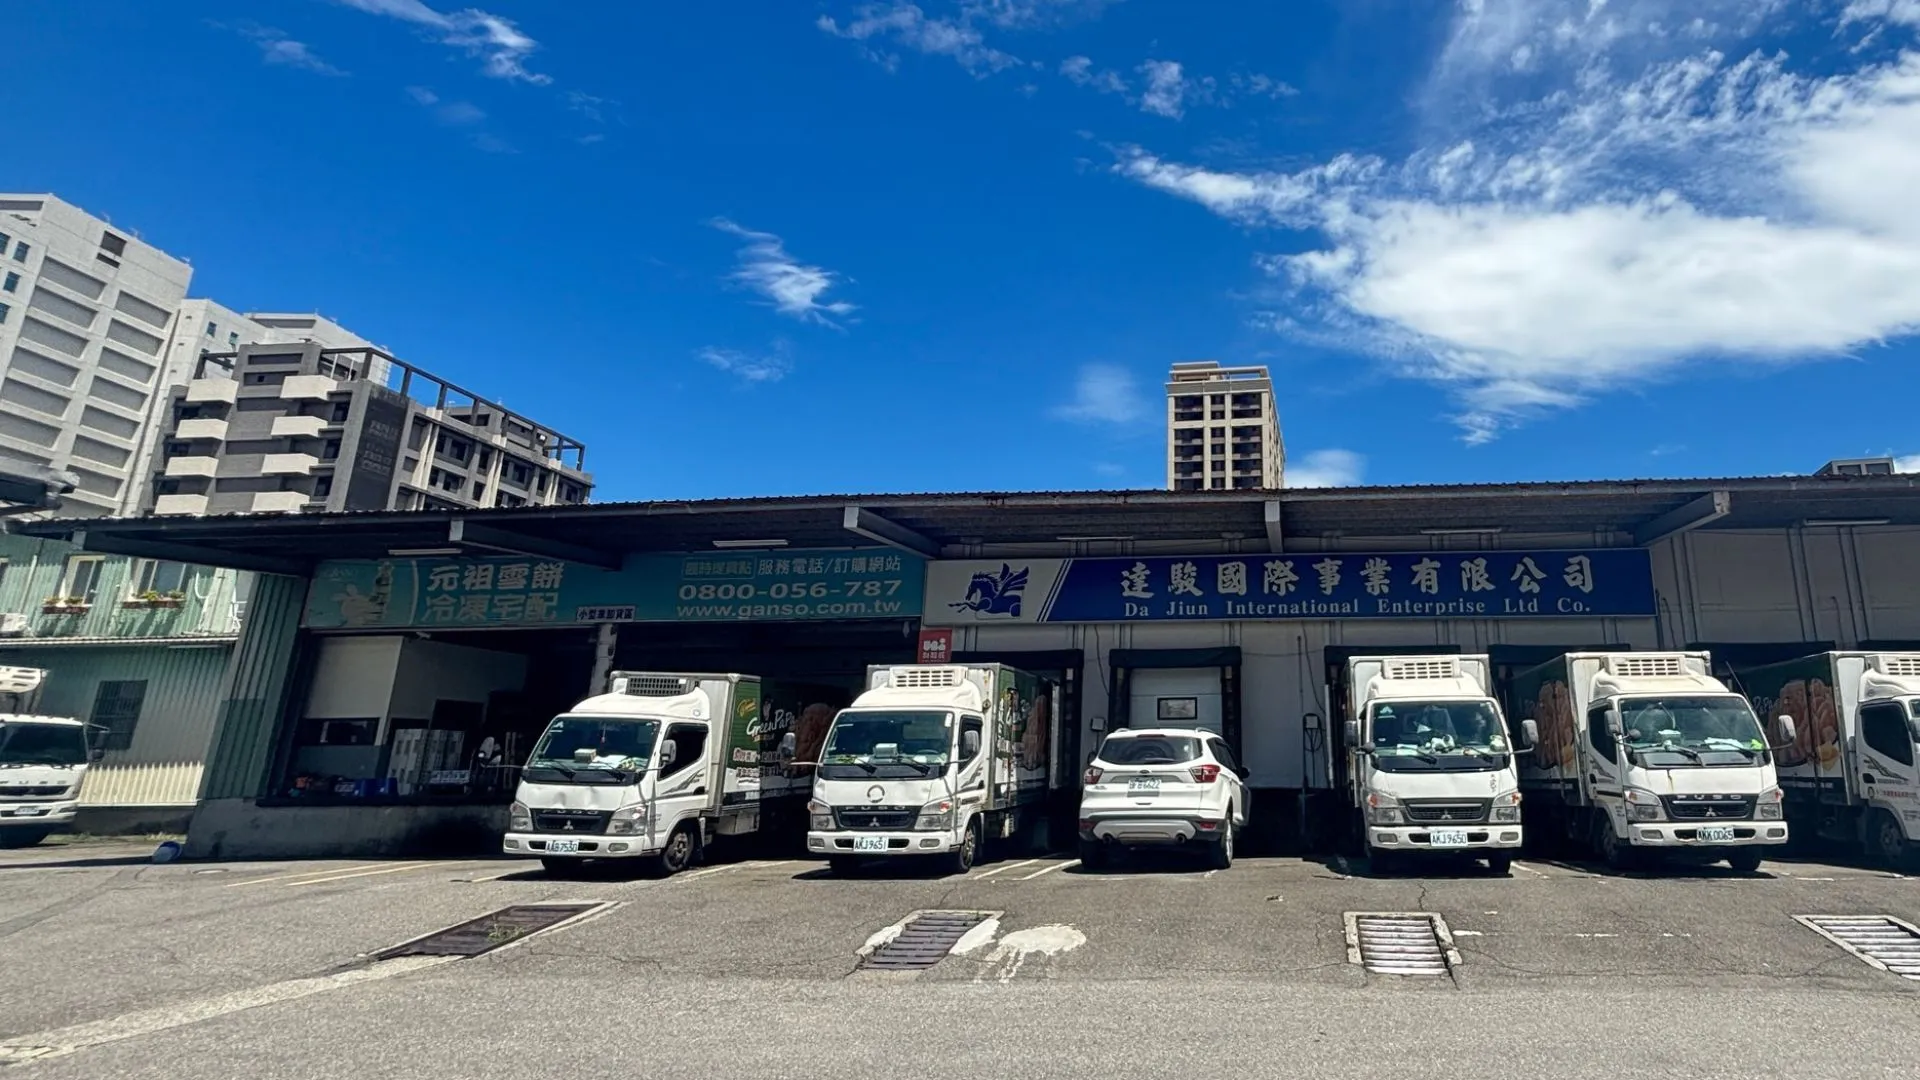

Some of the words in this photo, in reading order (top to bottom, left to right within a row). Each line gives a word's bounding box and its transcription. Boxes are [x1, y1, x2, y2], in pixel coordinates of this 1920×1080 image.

[426, 562, 564, 591] 元祖雪餅
[1121, 556, 1594, 598] 達駿國際事業有限公司
[679, 580, 903, 600] 0800-056-787
[421, 592, 559, 623] 冷凍宅配
[676, 599, 902, 618] www.ganso.com.tw
[1124, 602, 1150, 617] Da
[1166, 601, 1208, 616] Jiun
[1226, 599, 1359, 615] International
[1377, 597, 1486, 616] Enterprise
[1504, 598, 1539, 613] Ltd
[1557, 597, 1591, 612] Co.
